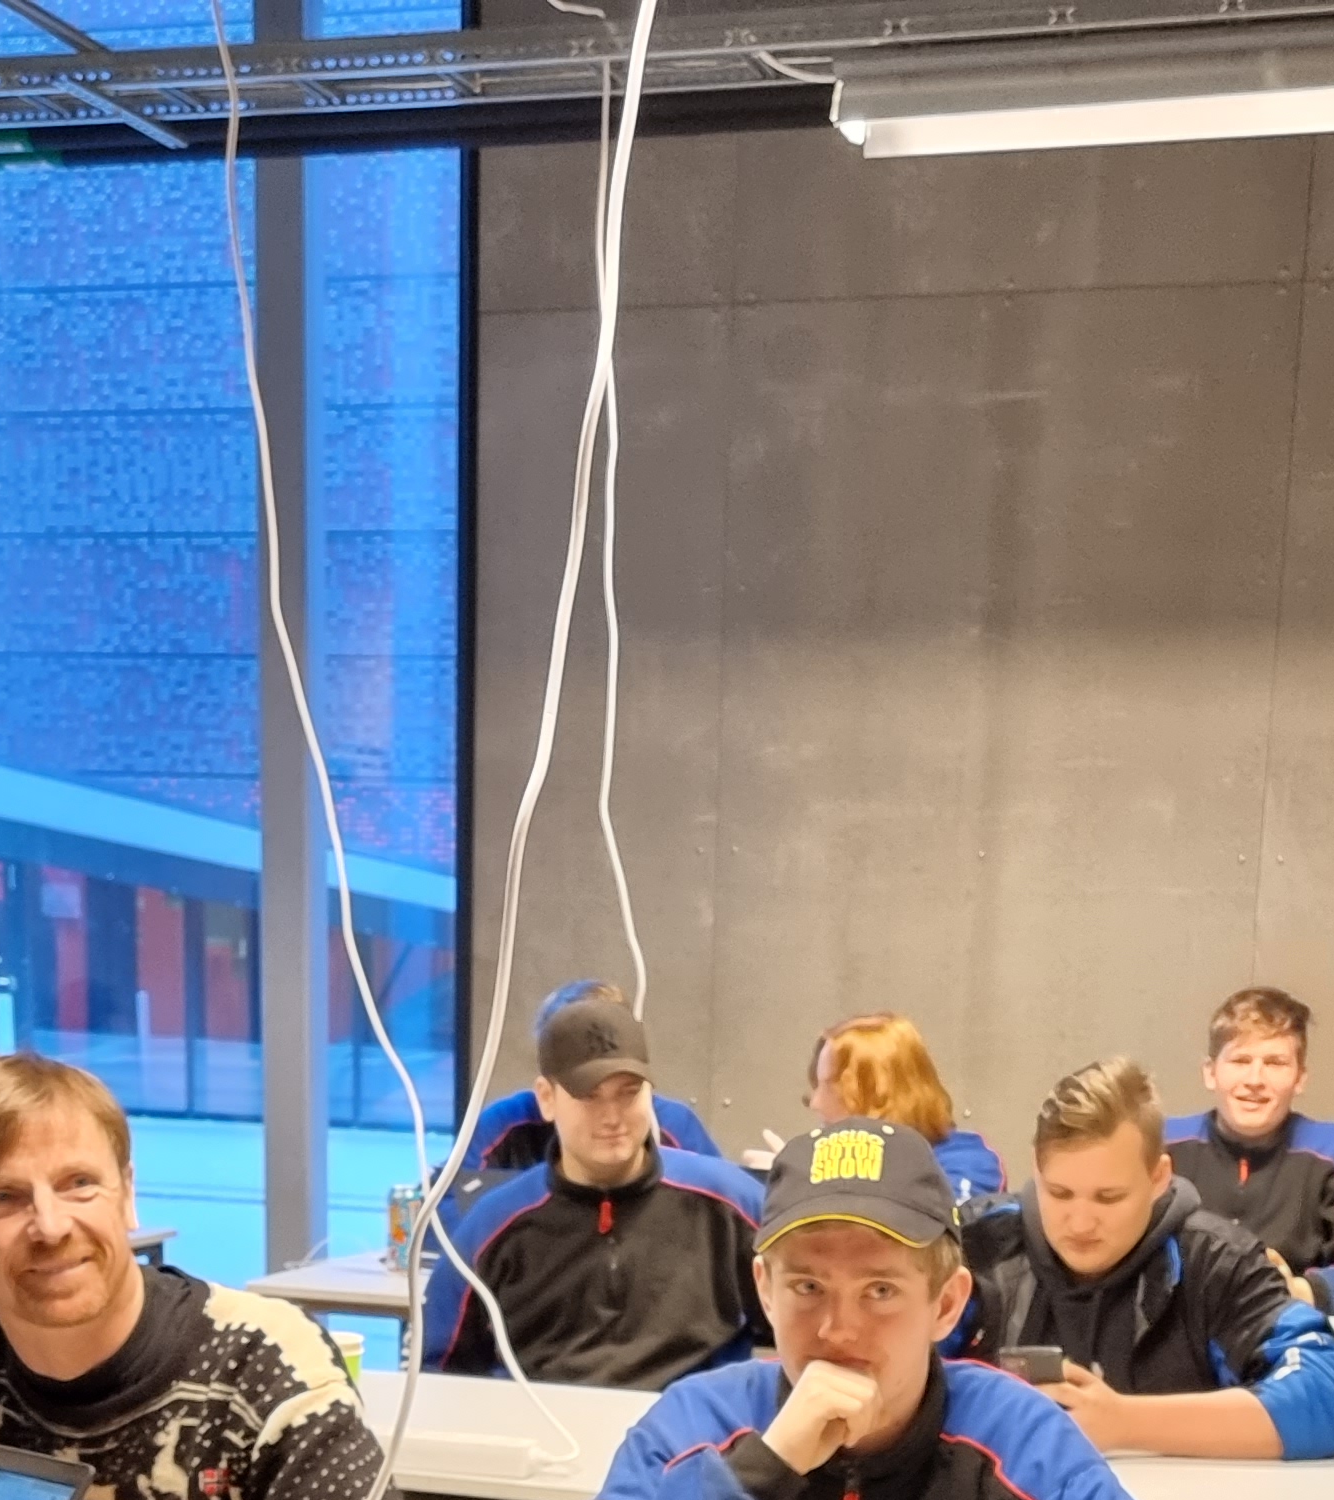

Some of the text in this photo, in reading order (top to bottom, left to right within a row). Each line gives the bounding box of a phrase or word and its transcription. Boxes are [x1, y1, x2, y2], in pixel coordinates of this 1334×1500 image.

[828, 1129, 870, 1145] OSLO
[813, 1141, 884, 1163] MOTOR
[809, 1157, 882, 1184] SHOW
